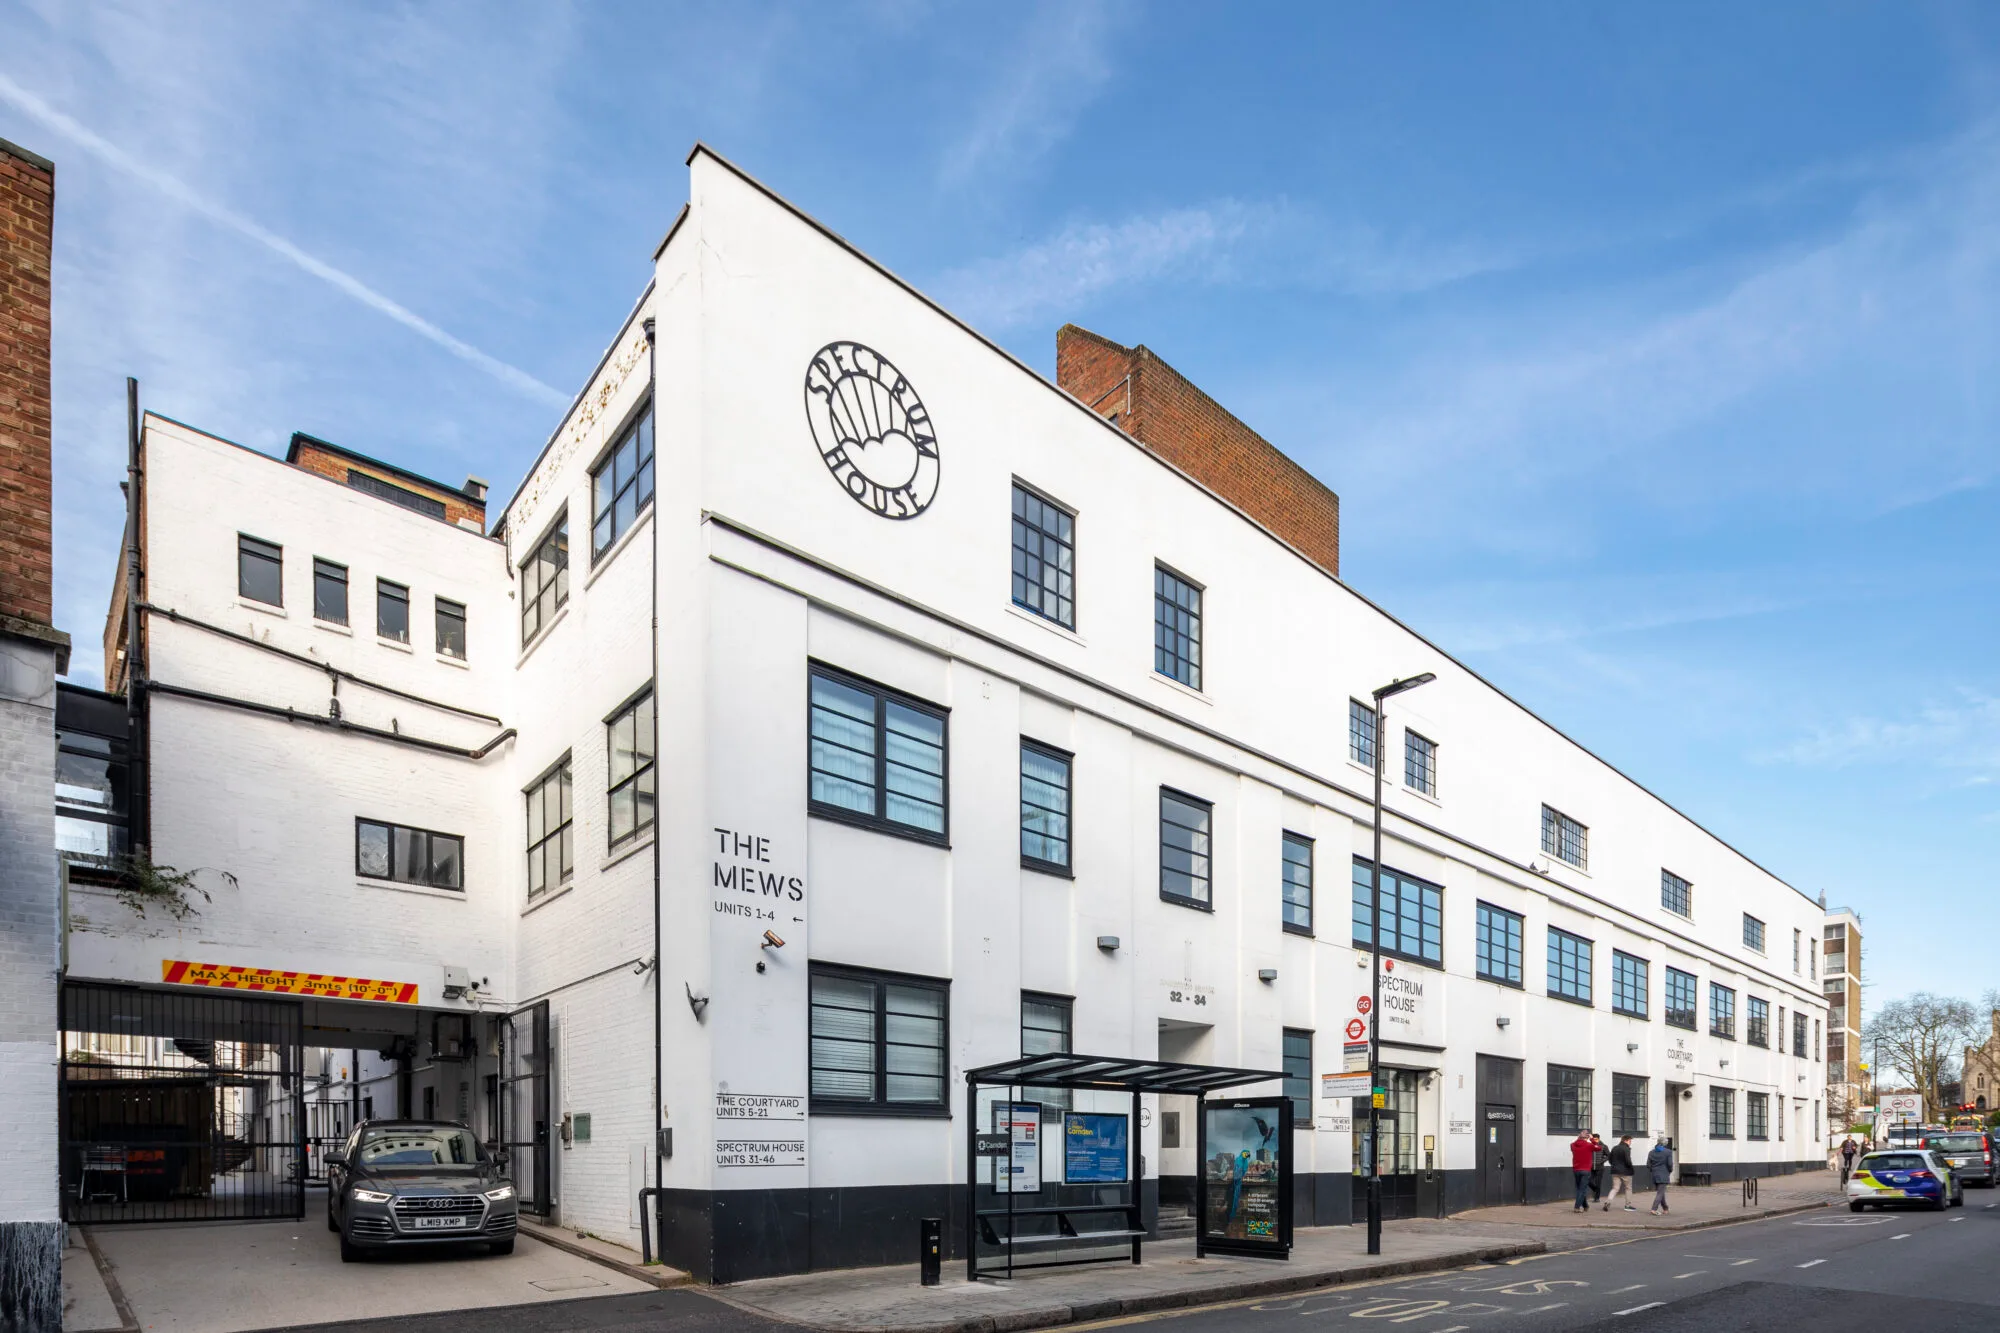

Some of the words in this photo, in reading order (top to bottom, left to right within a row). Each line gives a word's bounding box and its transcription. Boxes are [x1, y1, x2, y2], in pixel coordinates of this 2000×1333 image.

[807, 344, 939, 459] SPECTRUM
[823, 445, 925, 519] HOUSE
[714, 827, 770, 863] THE
[714, 862, 803, 902] MEWS
[714, 900, 752, 917] UNITS
[756, 908, 775, 921] 1-4
[190, 969, 231, 981] MAX
[238, 974, 297, 987] HEIGHT
[304, 980, 342, 991] 3mts
[1170, 991, 1182, 1002] 32
[1194, 994, 1206, 1006] 34
[1358, 1001, 1369, 1009] GG
[1384, 994, 1415, 1013] HOUSE
[1667, 1048, 1693, 1062] COURTYARD
[716, 1096, 736, 1106] THE
[738, 1097, 799, 1108] COURTYARD
[716, 1107, 745, 1117] UNITS
[748, 1108, 768, 1117] 5-21
[1067, 1128, 1093, 1136] Camden
[716, 1143, 770, 1152] SPECTRUM
[772, 1143, 805, 1152] HOUSE
[985, 1141, 1008, 1149] Camden
[716, 1155, 746, 1164] UNITS
[748, 1155, 775, 1164] 31-46
[421, 1218, 441, 1226] LM19
[443, 1217, 461, 1226] XMP
